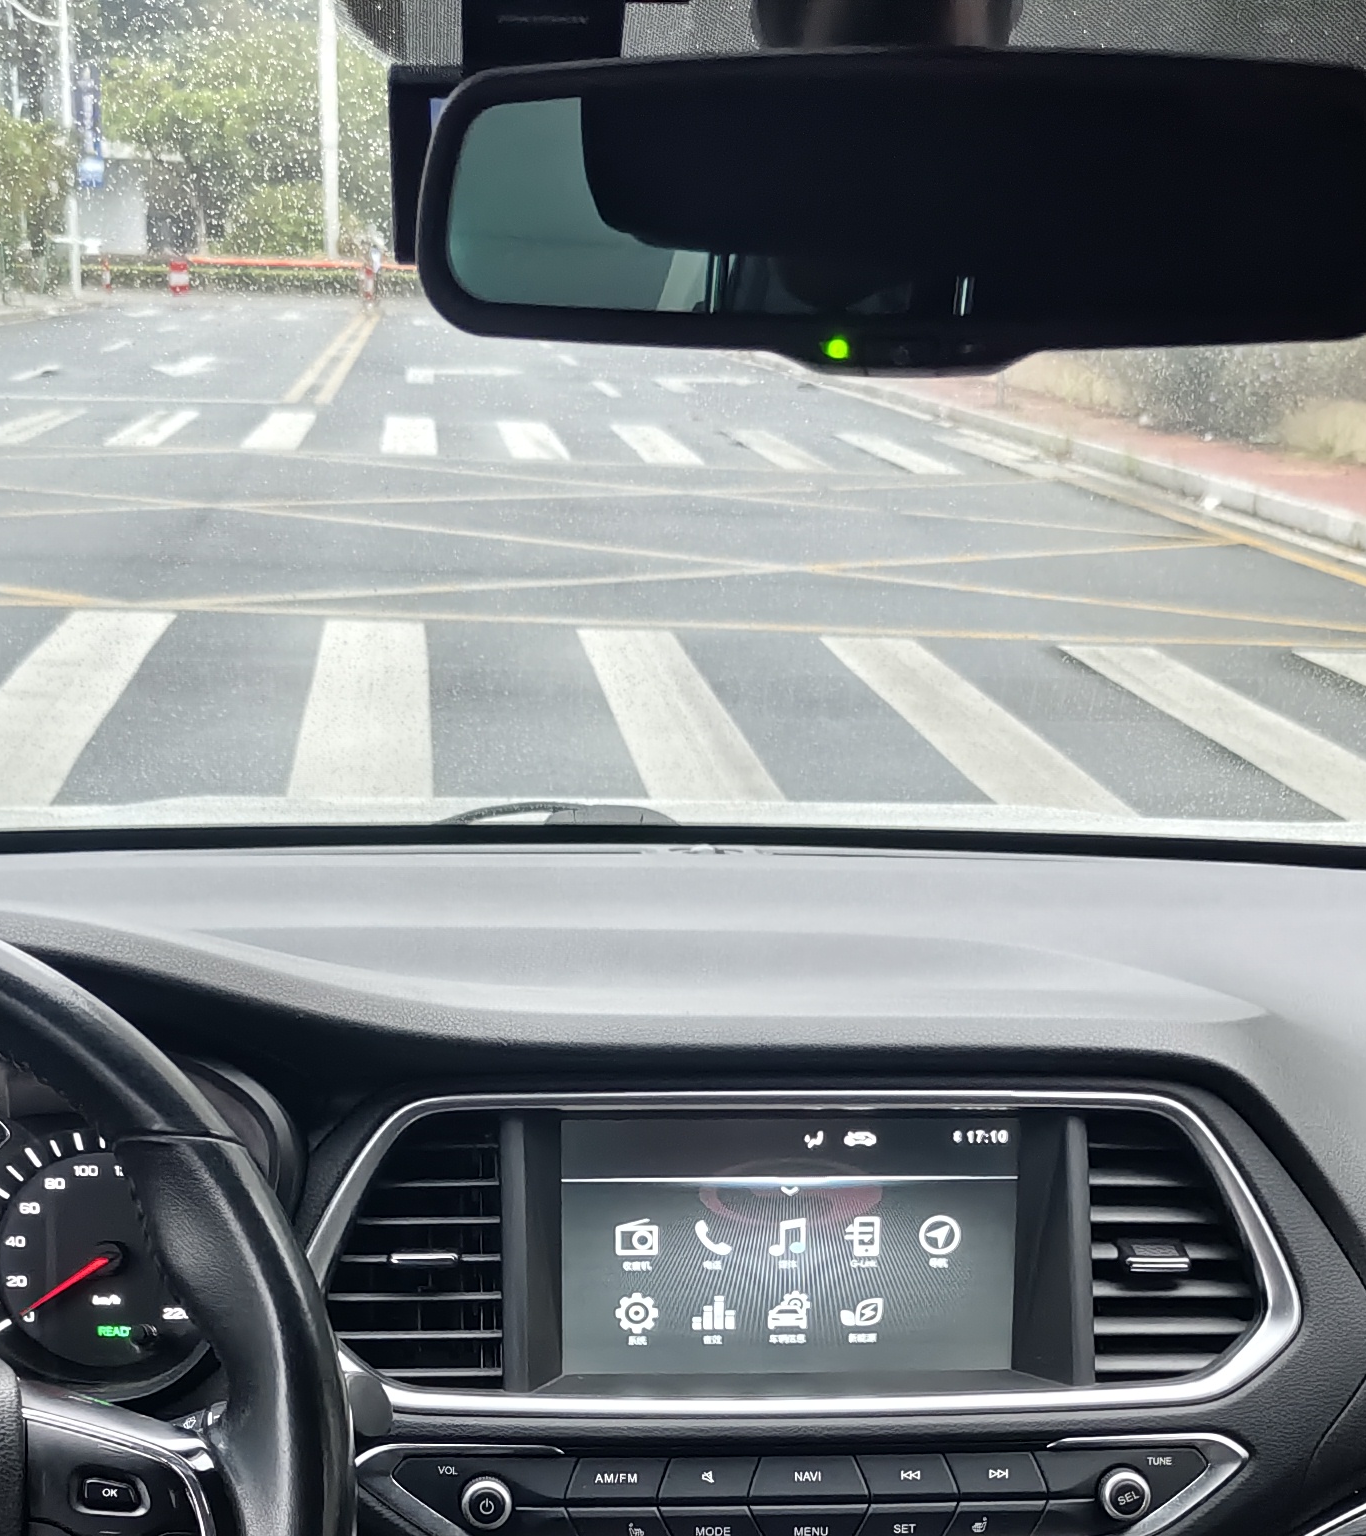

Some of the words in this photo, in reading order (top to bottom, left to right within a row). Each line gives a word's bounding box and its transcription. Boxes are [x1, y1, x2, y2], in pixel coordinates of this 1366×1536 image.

[73, 1165, 98, 1177] 100
[44, 1178, 66, 1190] 80
[19, 1202, 41, 1214] 60
[5, 1236, 26, 1248] 40
[5, 1275, 27, 1287] 20
[1146, 1456, 1173, 1466] TUNE
[437, 1466, 459, 1476] VOL
[794, 1471, 822, 1482] NAVI
[594, 1472, 638, 1484] AM/FM
[102, 1487, 118, 1498] OK
[1117, 1490, 1140, 1506] SEL
[695, 1526, 731, 1536] MODE
[793, 1526, 829, 1536] MENU
[893, 1523, 917, 1534] SET
